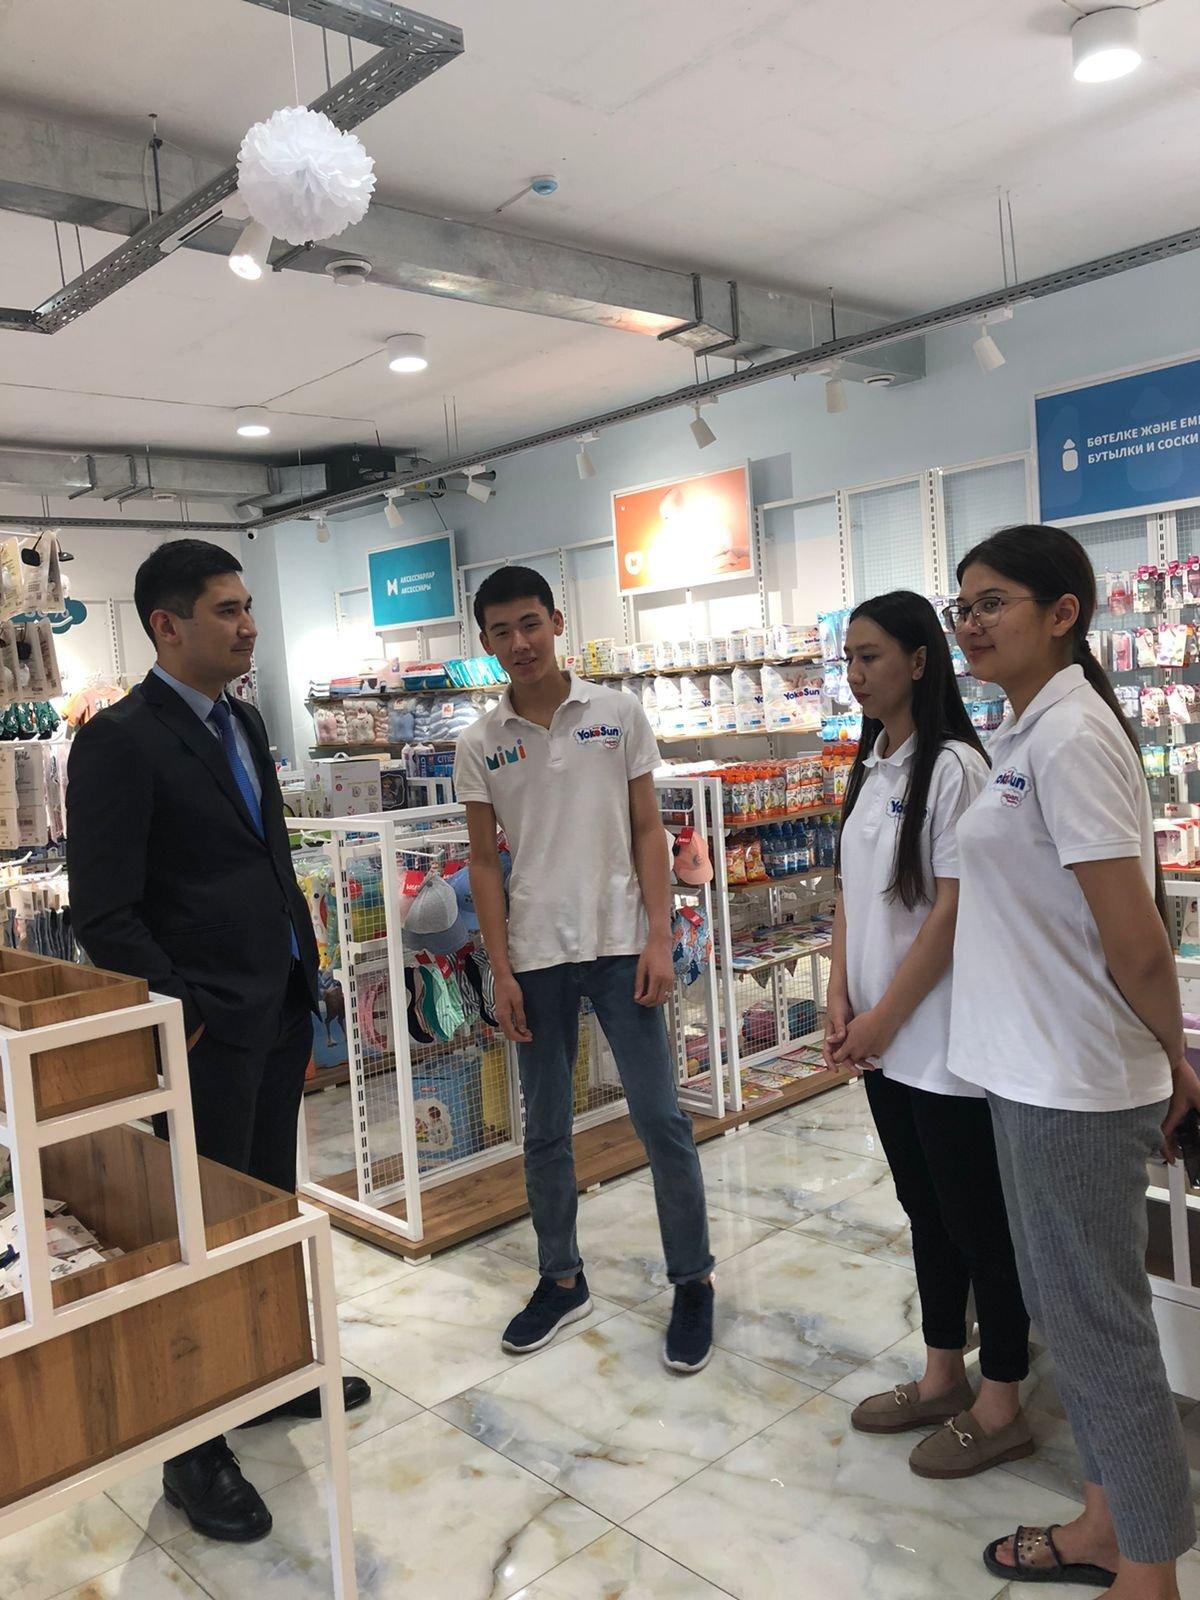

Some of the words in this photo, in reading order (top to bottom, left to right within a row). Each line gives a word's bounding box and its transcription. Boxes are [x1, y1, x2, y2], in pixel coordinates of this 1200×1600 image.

[1087, 428, 1139, 448] БӨТЕЛКЕ
[1141, 419, 1177, 437] ЖӘНЕ
[1088, 443, 1143, 464] БУТЫЛКИ
[1147, 441, 1155, 453] И
[1157, 432, 1199, 450] СОСКИ
[784, 687, 820, 701] YokoSun
[577, 726, 619, 741] YokoSun
